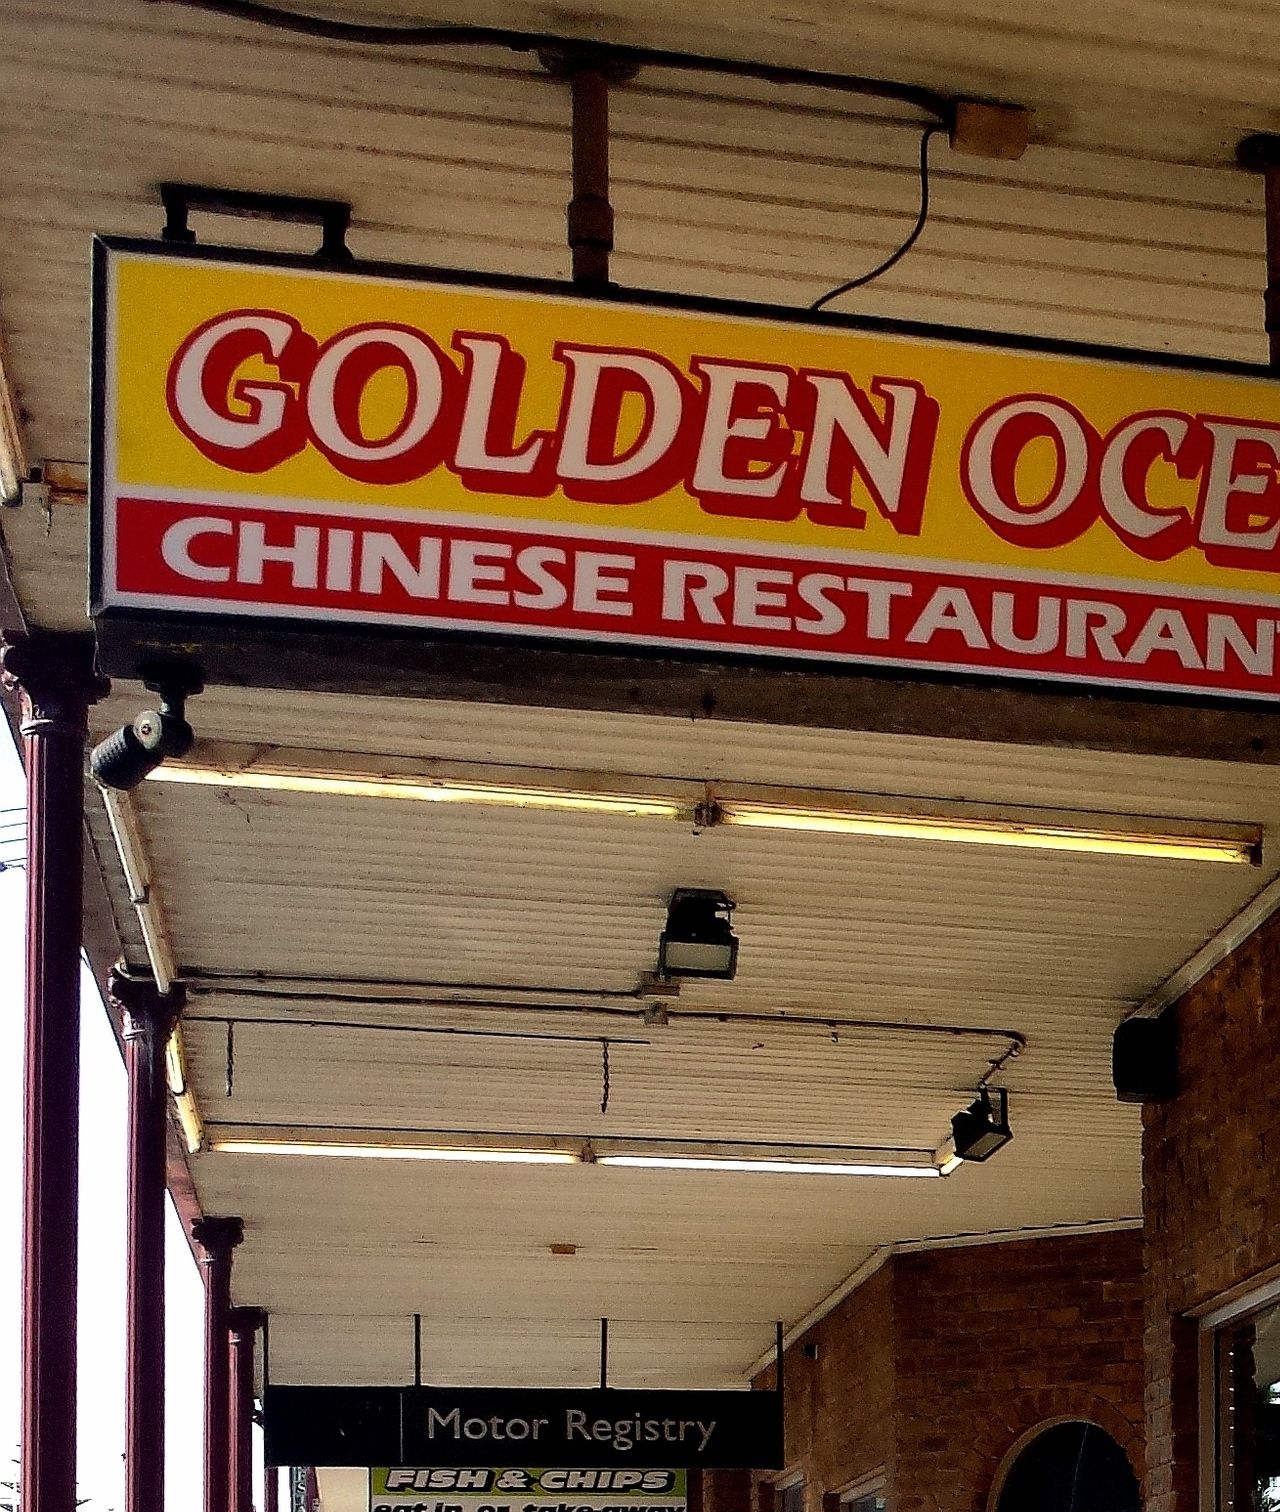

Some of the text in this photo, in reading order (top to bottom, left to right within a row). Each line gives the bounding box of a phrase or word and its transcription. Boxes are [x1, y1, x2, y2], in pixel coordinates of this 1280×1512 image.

[166, 308, 939, 535] GOLDEN
[161, 516, 634, 619] CHINESE
[427, 1407, 717, 1452] Motor Registry
[385, 1469, 676, 1493] FISH & CHIPS
